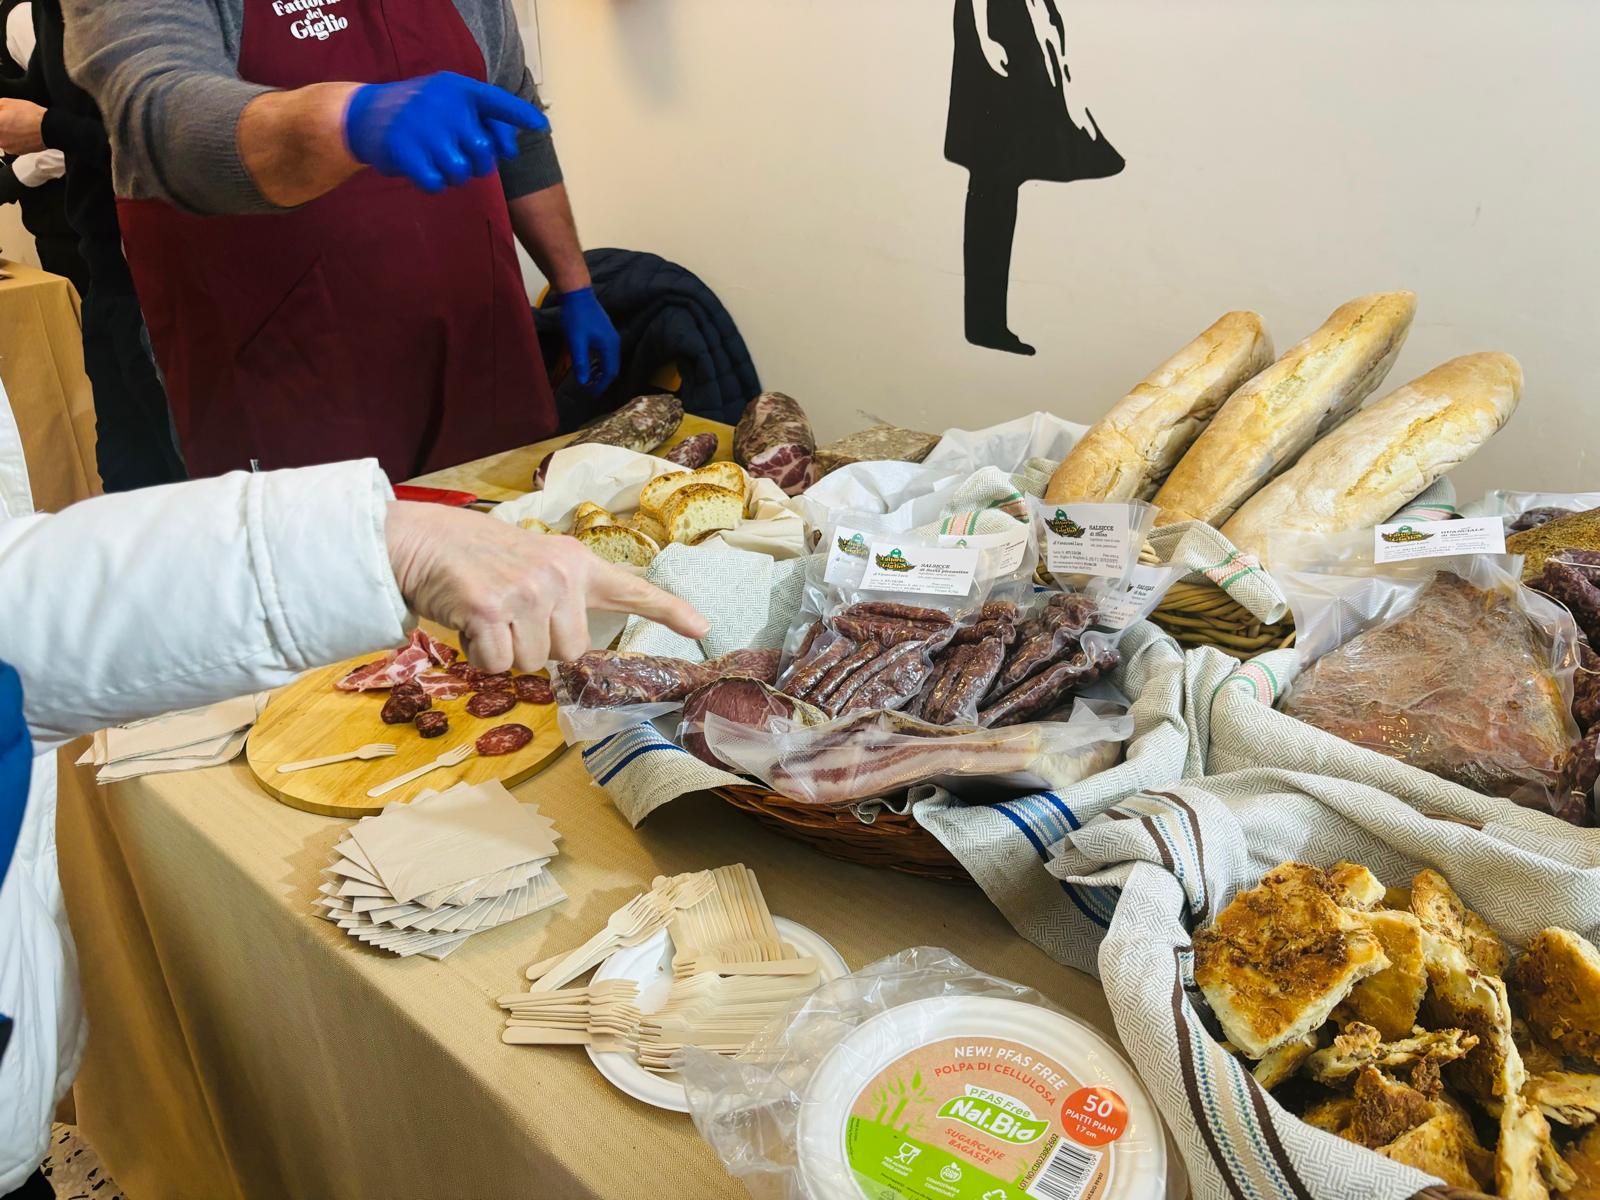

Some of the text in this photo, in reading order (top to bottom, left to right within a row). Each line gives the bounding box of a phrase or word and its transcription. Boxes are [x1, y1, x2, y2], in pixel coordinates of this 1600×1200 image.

[290, 14, 348, 40] Giglio
[306, 8, 324, 20] del
[954, 1046, 1069, 1092] NEW! PFAS FREE
[934, 1062, 1056, 1107] POLPA DI CELLULOSA
[969, 1088, 1031, 1118] PFAS Free
[1083, 1094, 1113, 1118] 50
[950, 1100, 1036, 1141] Nat.Bio
[1065, 1108, 1118, 1136] PIATTI PIANI
[1075, 1124, 1097, 1139] 17 cm
[944, 1128, 1006, 1161] SUGARCANE
[948, 1139, 994, 1165] BAGASSE
